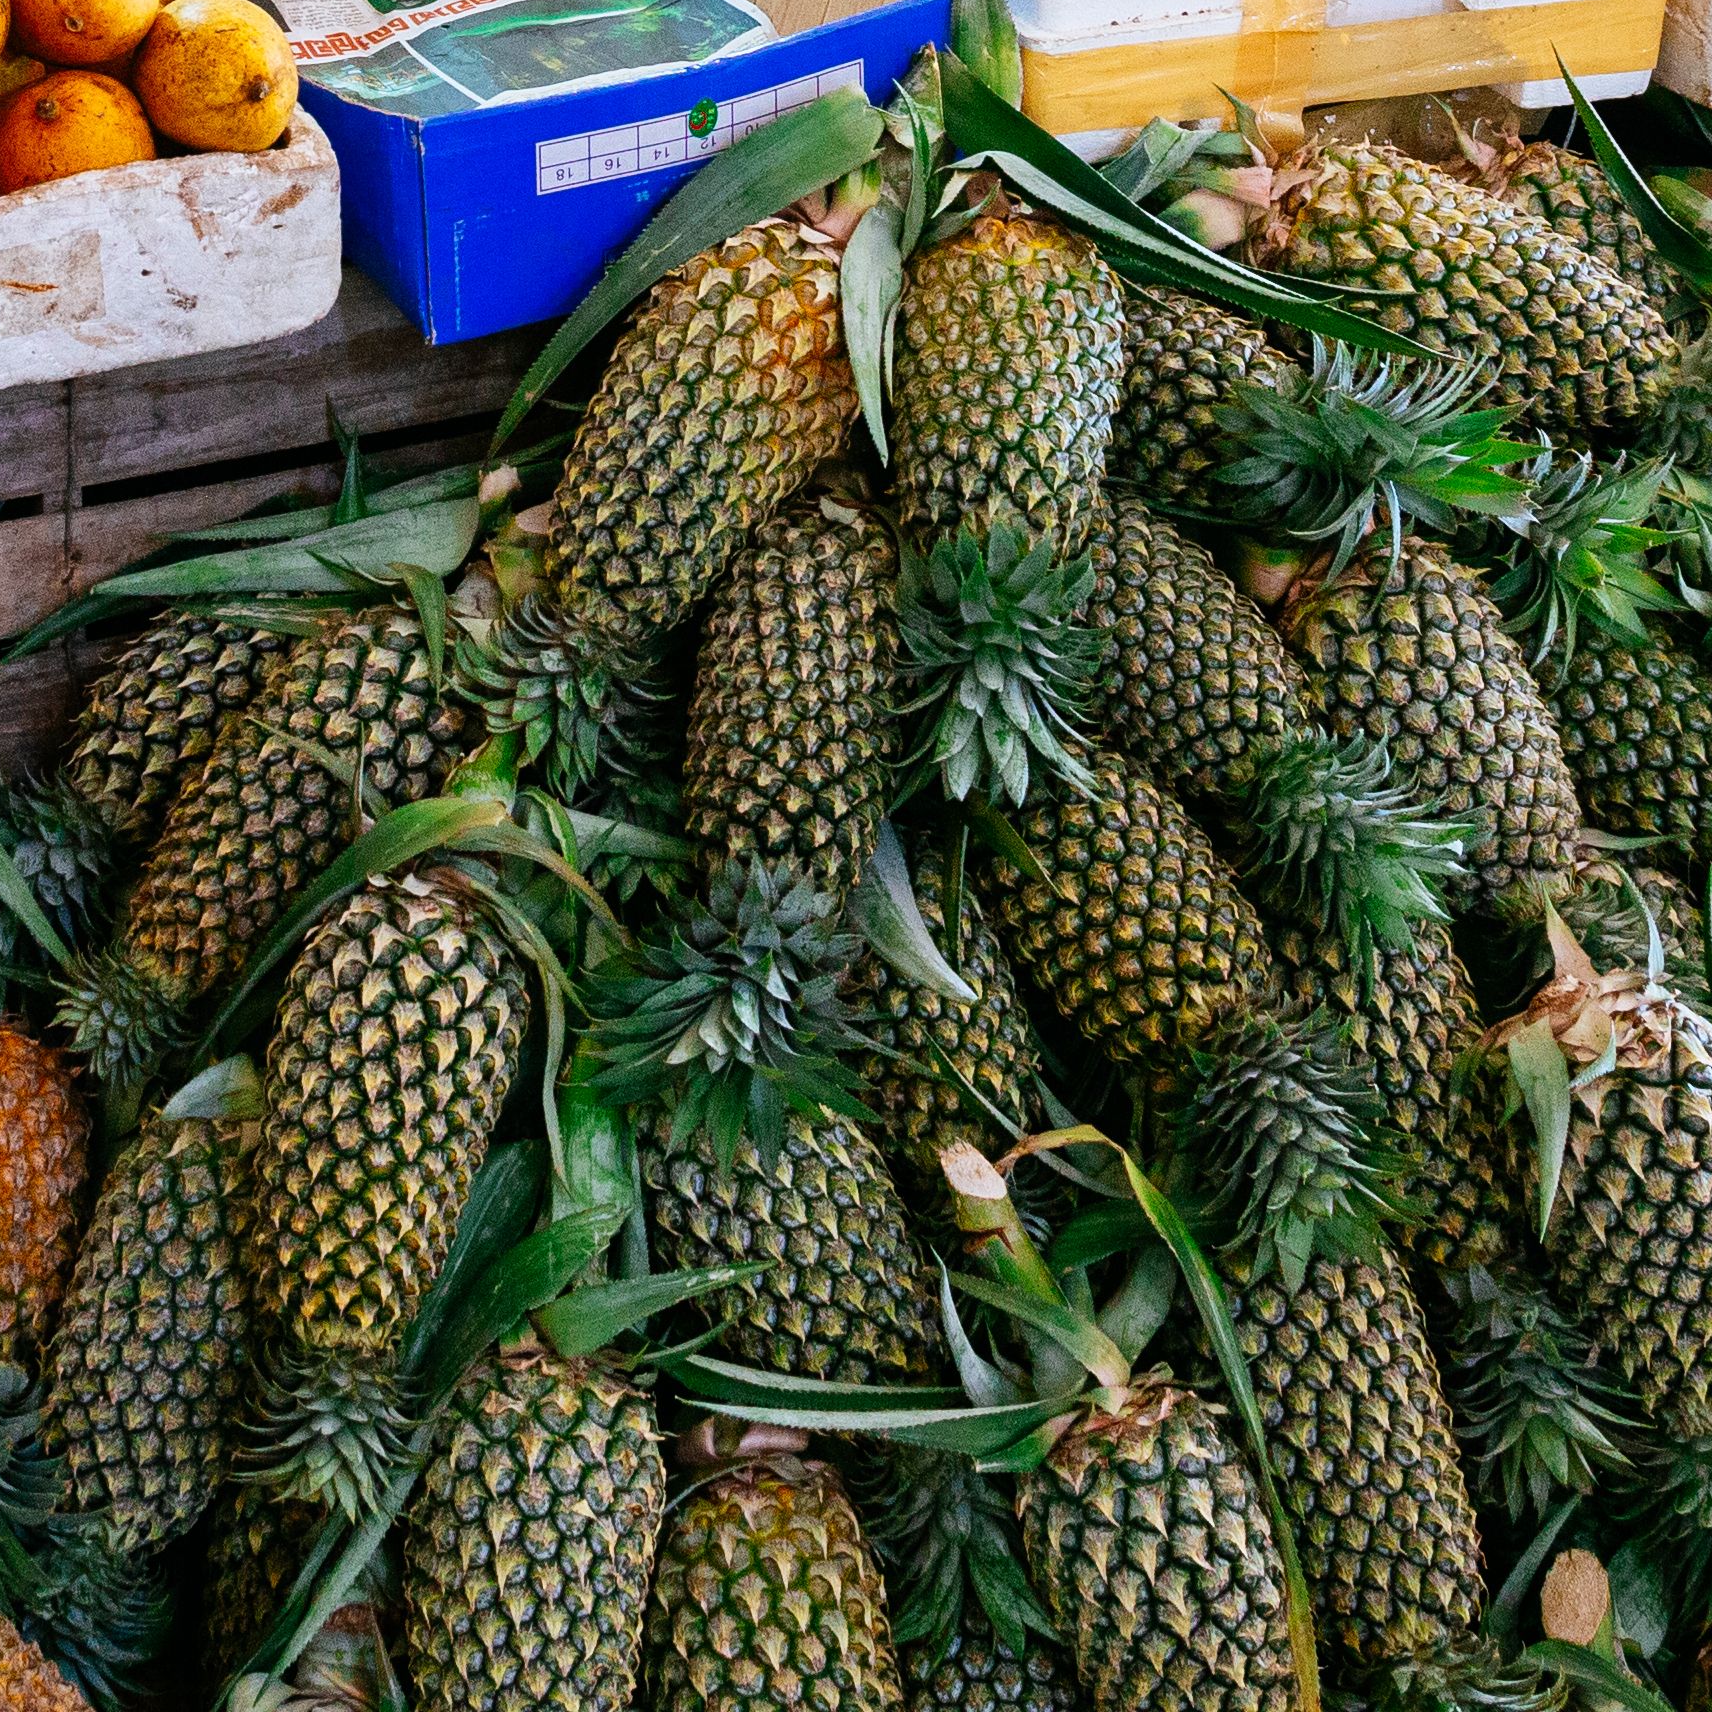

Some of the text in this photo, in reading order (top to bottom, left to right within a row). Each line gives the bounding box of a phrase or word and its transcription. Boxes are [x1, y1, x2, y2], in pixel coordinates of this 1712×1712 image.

[700, 136, 717, 150] 12
[654, 147, 670, 161] 14
[604, 157, 621, 171] 16
[556, 167, 573, 181] 18
